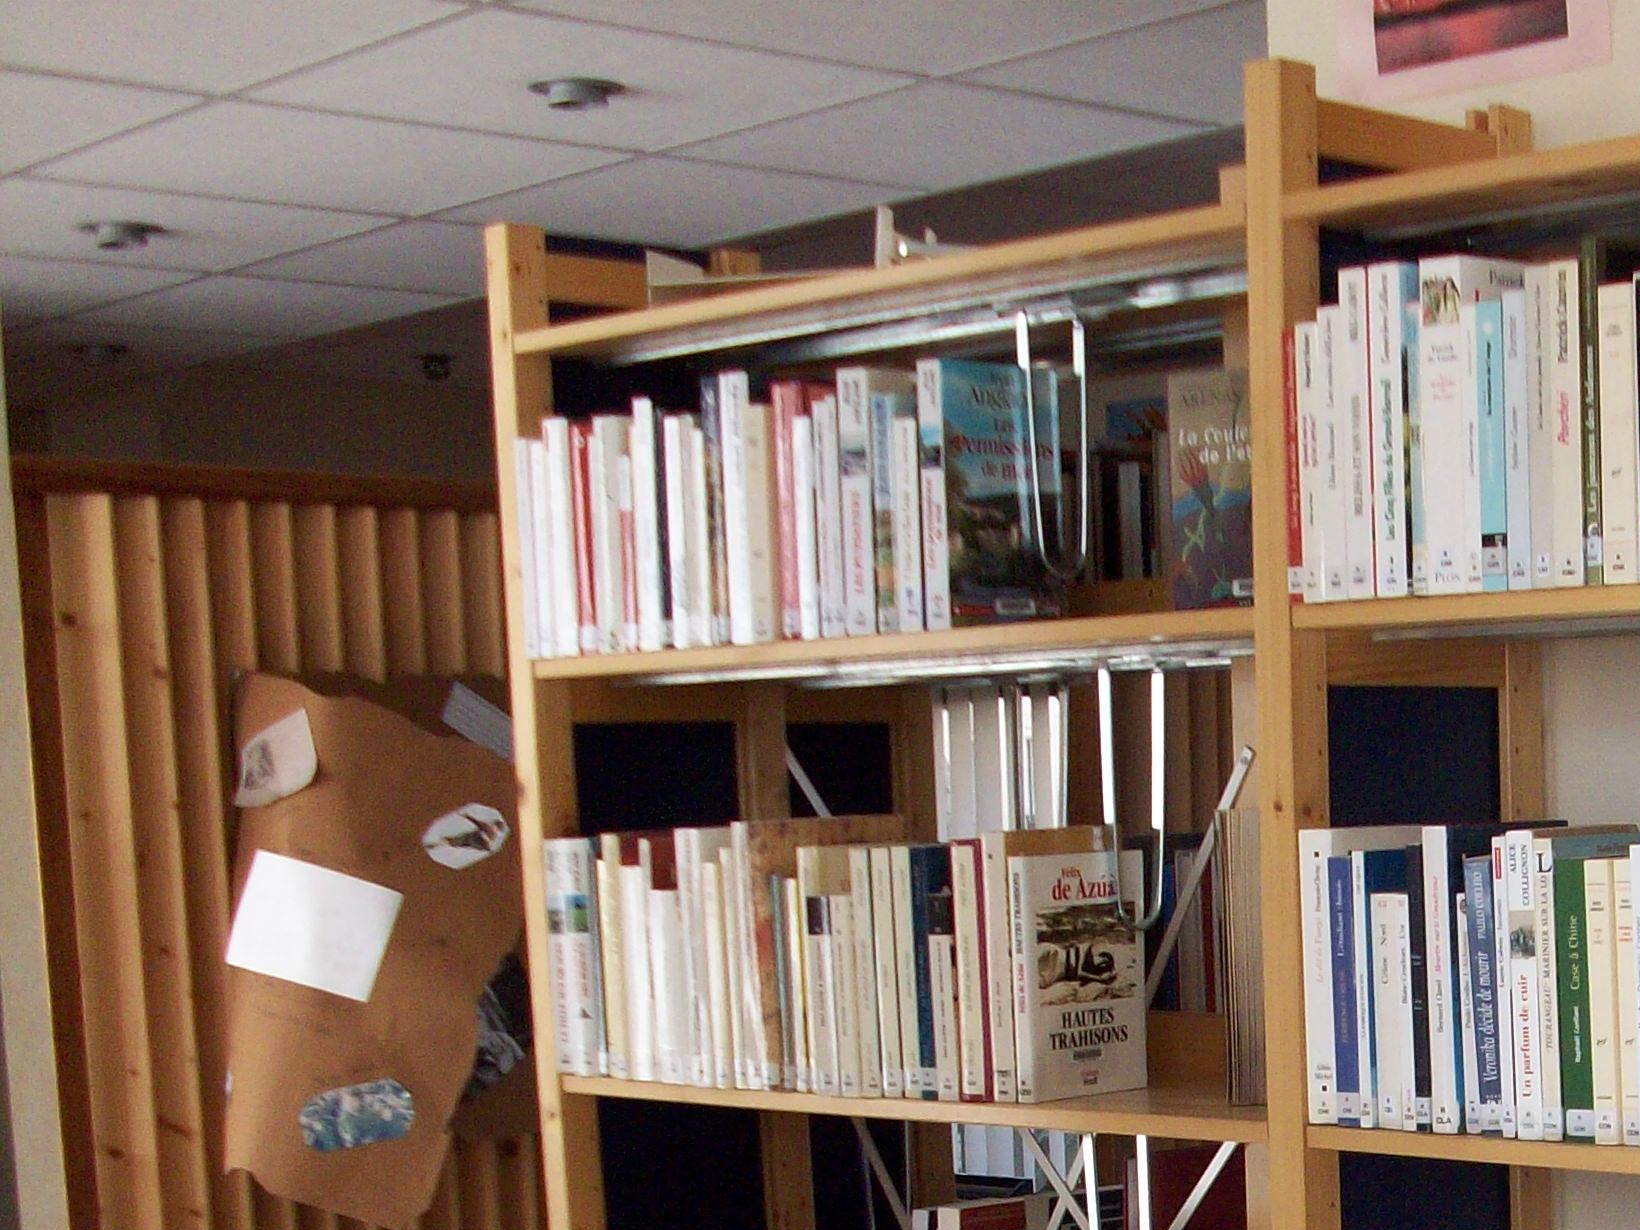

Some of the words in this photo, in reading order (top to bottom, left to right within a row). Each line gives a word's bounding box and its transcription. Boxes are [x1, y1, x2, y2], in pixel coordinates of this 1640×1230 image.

[1567, 915, 1579, 948] Chine
[1476, 951, 1490, 984] mourir
[1569, 963, 1580, 991] Case
[1479, 988, 1491, 1001] de
[1517, 973, 1529, 1002] cuir
[1062, 1007, 1114, 1028] HAUTES
[1480, 1004, 1494, 1034] décide
[1518, 1005, 1530, 1022] de
[1050, 1025, 1128, 1051] TRAHISONS
[1520, 1026, 1534, 1075] parfum
[1480, 1037, 1498, 1082] Veronika
[1521, 1078, 1533, 1098] Un
